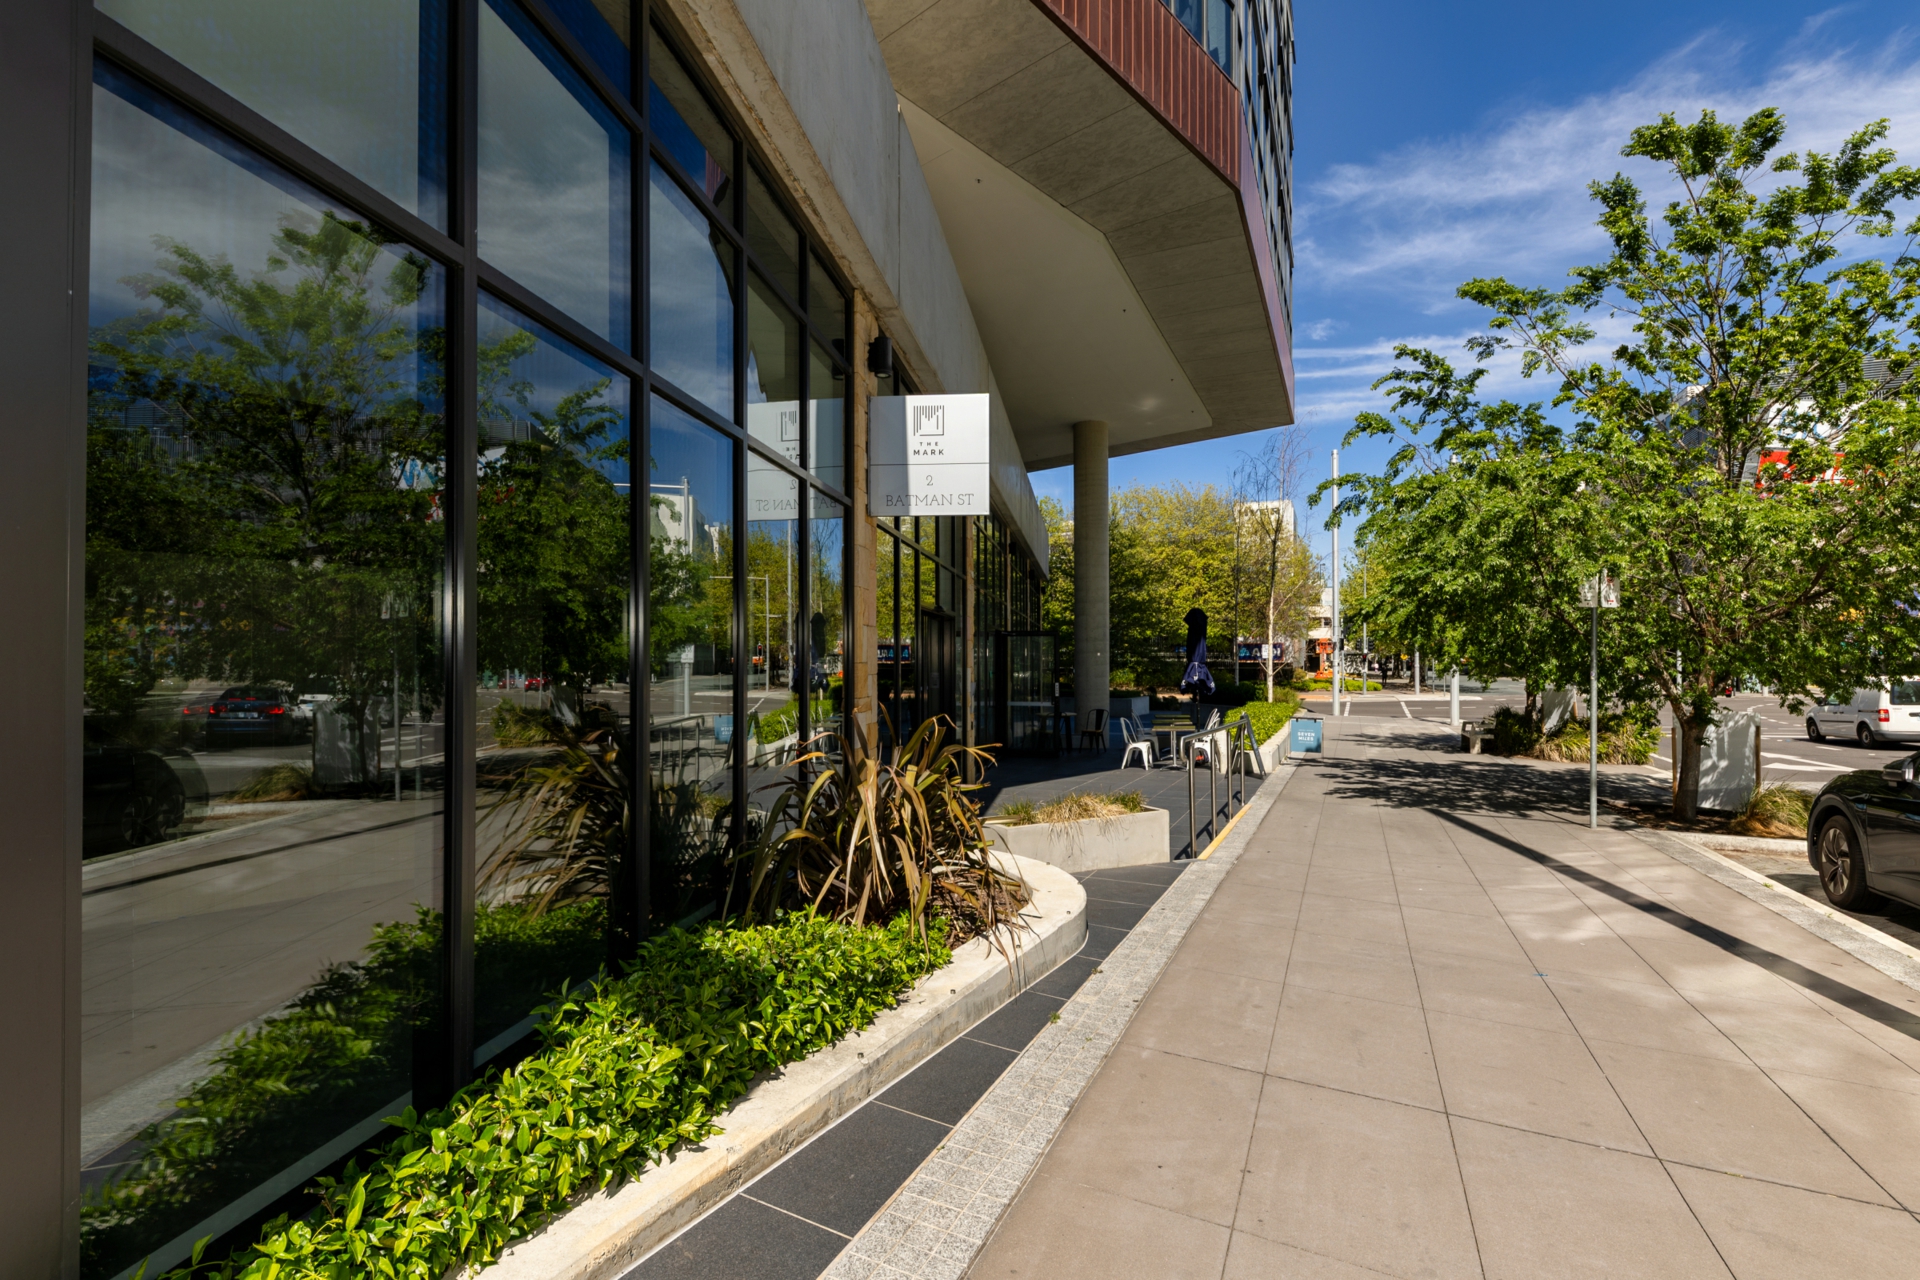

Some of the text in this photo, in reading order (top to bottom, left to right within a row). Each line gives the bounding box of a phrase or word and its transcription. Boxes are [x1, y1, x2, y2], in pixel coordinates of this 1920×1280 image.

[925, 474, 934, 487] 2
[886, 493, 974, 507] BATMAN ST
